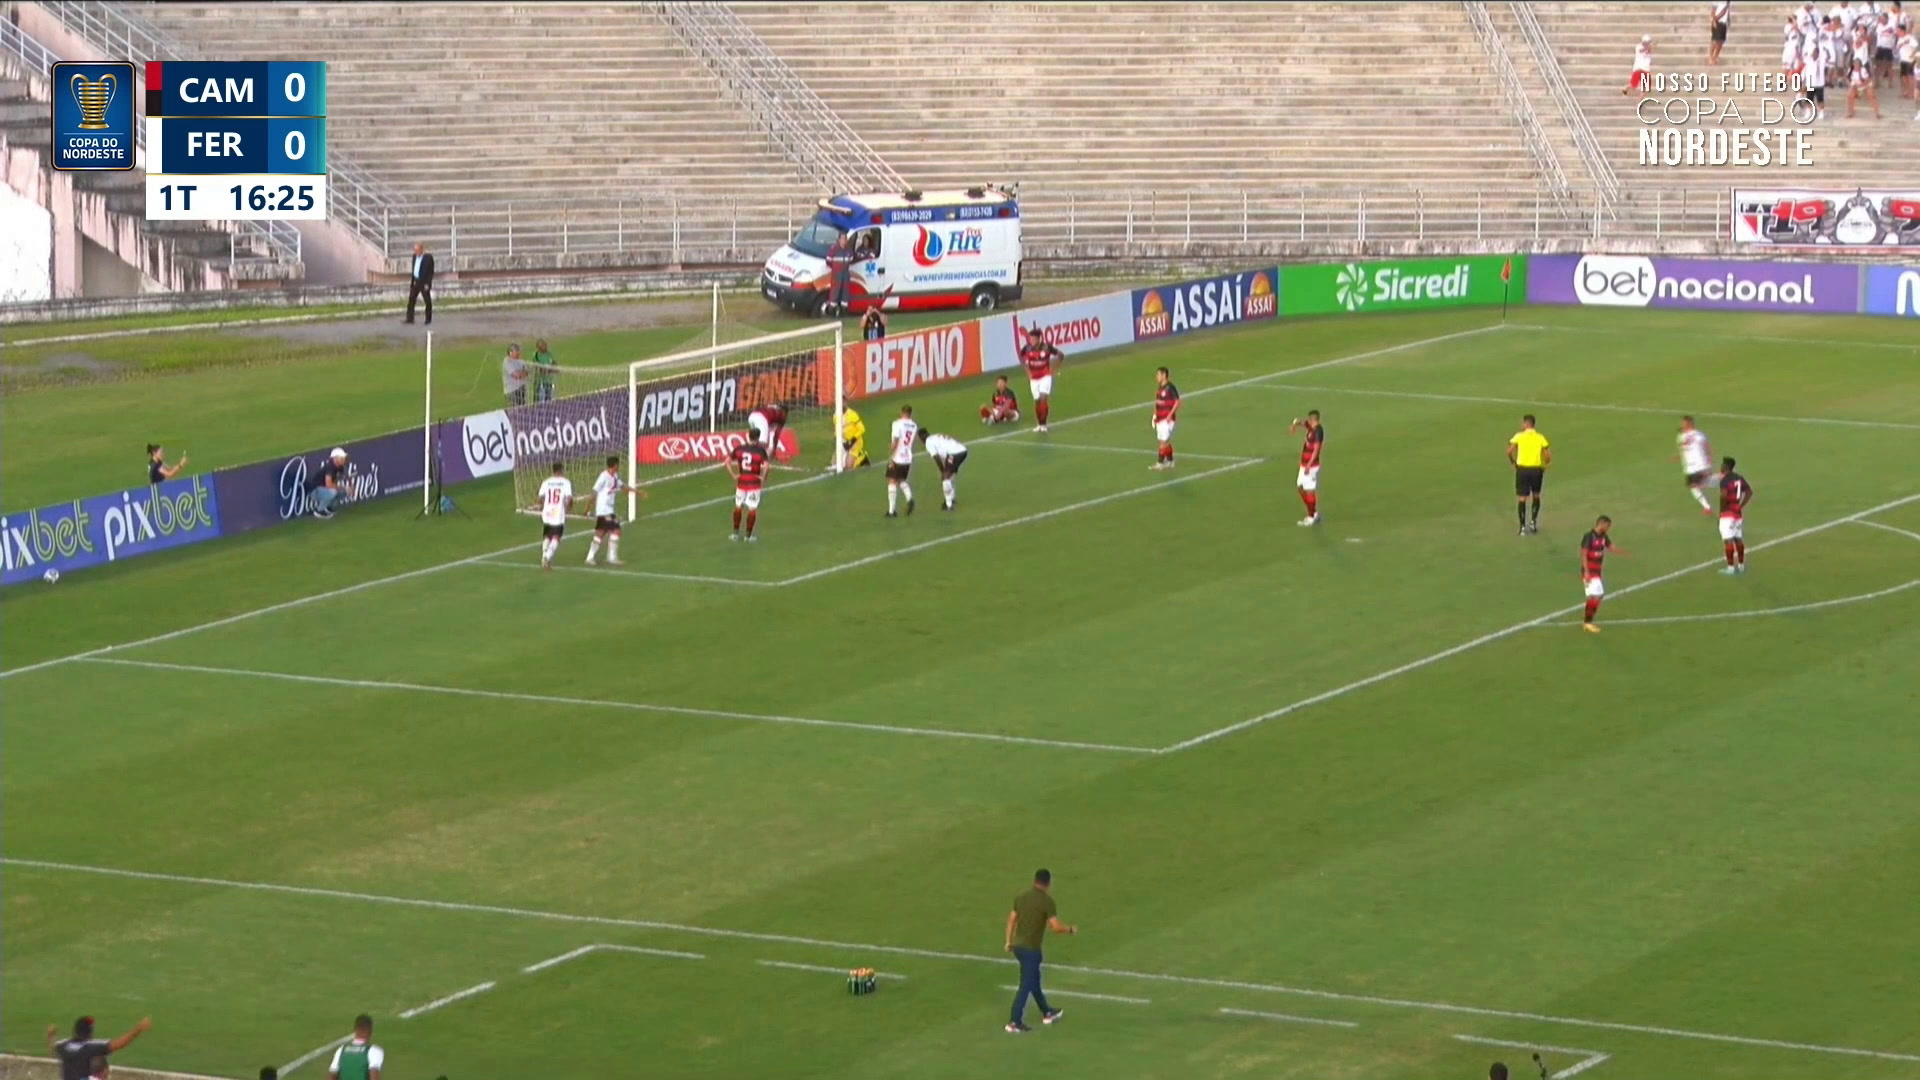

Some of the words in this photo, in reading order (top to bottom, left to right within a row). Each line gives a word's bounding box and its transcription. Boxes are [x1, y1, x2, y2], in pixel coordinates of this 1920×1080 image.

[1172, 273, 1244, 332] ASSAÍ
[1373, 263, 1470, 302] Sicredi
[1582, 262, 1649, 298] bet
[1658, 272, 1815, 304] nacional
[865, 326, 964, 394] BETANO
[638, 377, 737, 431] APOSTA
[737, 363, 818, 411] GANHA
[465, 422, 513, 466] bet
[516, 406, 611, 457] nacional
[689, 428, 787, 458] KRO
[741, 452, 753, 471] 2
[547, 488, 562, 505] 16
[1734, 480, 1743, 500] 7
[104, 474, 212, 562] pixbet
